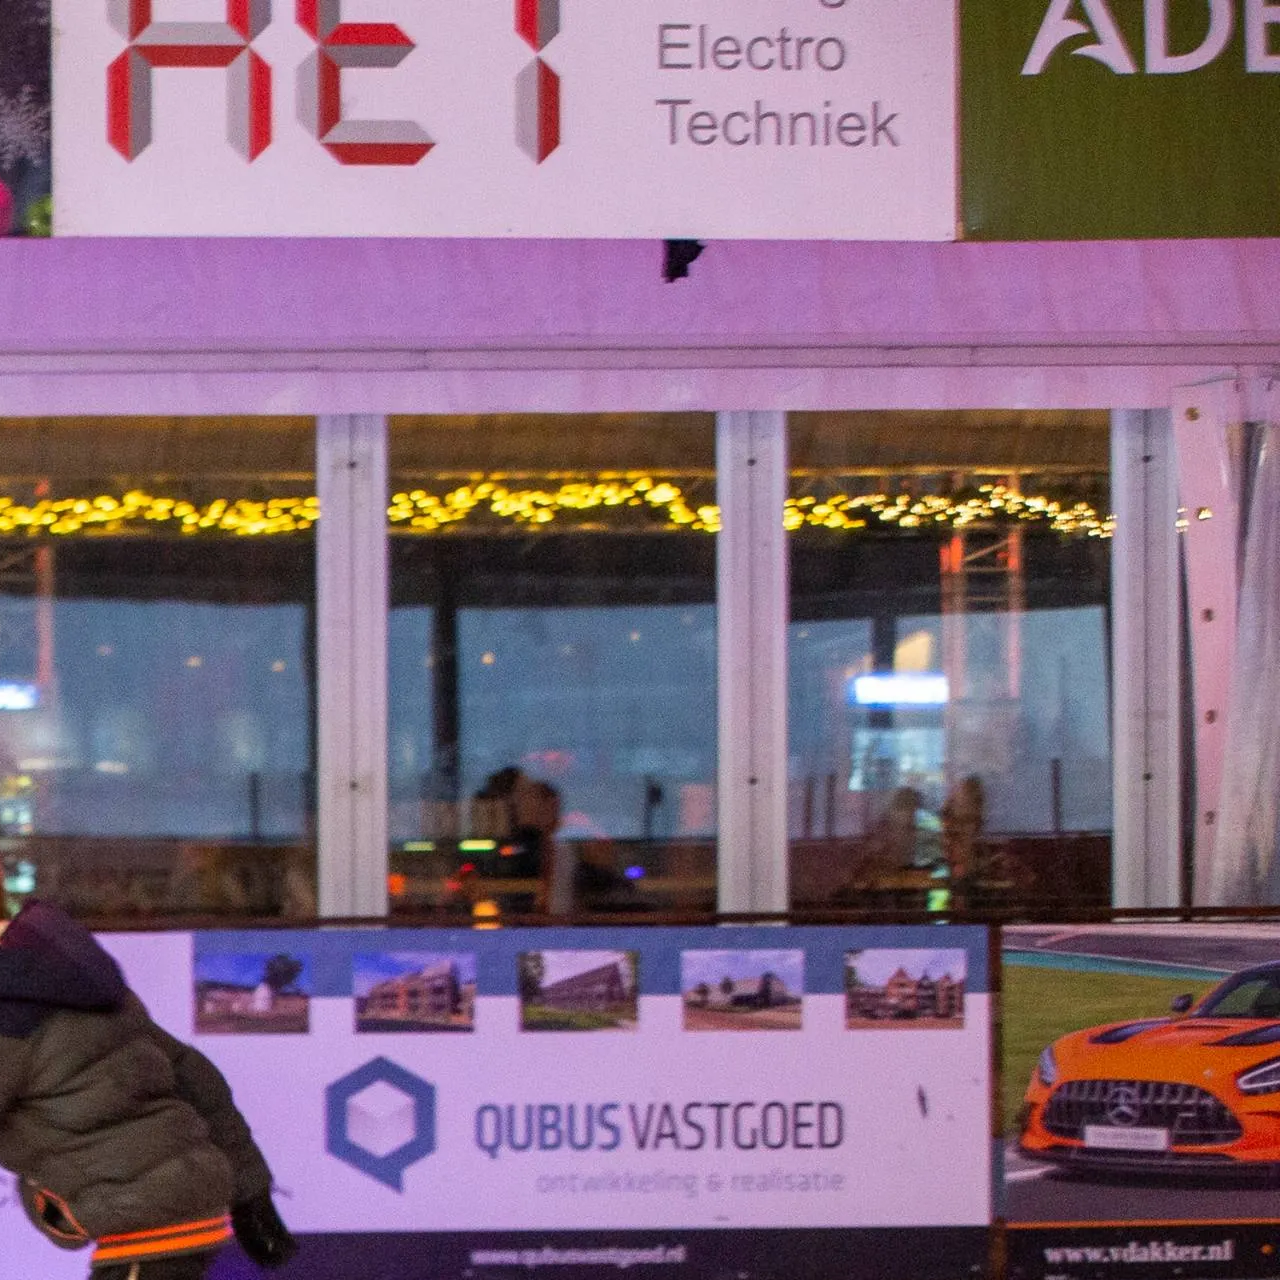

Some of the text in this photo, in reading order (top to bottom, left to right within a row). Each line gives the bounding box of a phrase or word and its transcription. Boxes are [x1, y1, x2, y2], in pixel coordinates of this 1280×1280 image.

[657, 24, 847, 71] Electro
[656, 100, 901, 147] Techniek
[474, 1102, 845, 1159] QUBUS VASTGOED
[537, 1170, 700, 1198] ontwikkeling
[732, 1169, 845, 1193] realisatie
[1043, 1240, 1234, 1264] www.vdakker.nl
